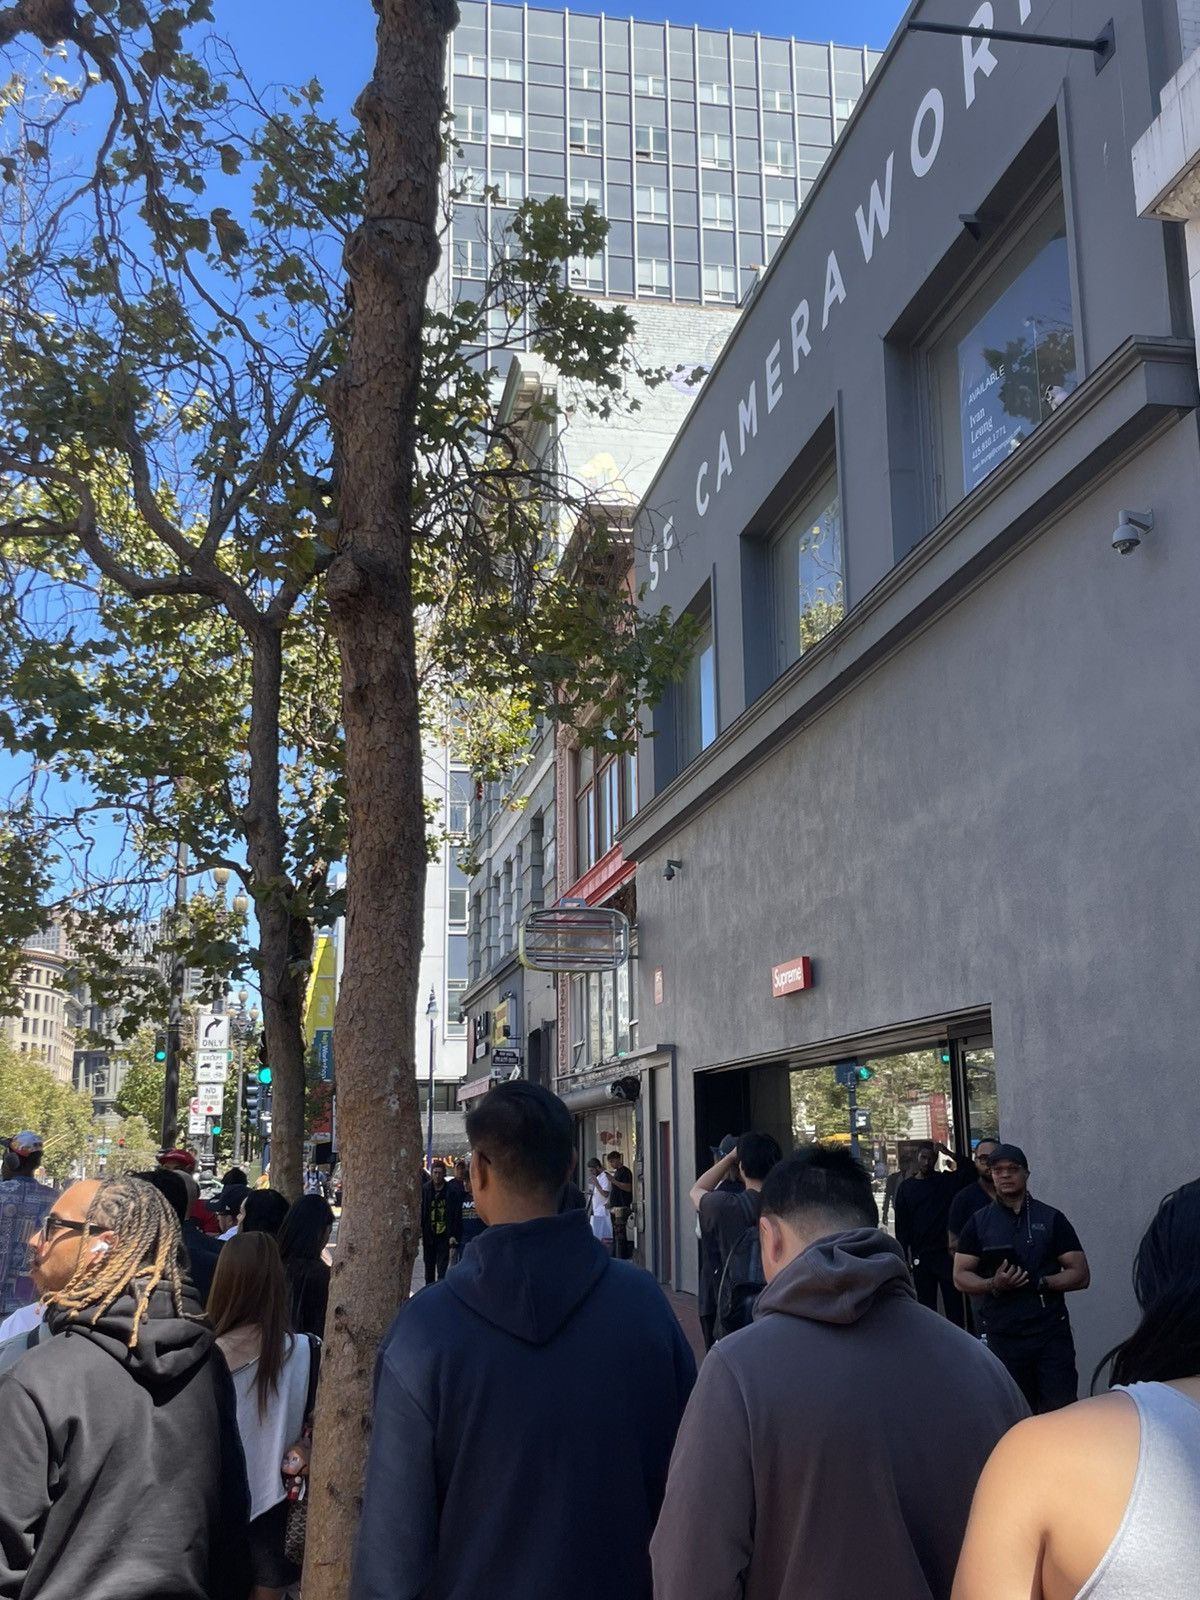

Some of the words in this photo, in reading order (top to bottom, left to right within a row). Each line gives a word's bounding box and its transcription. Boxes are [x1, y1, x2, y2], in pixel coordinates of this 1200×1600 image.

[649, 515, 674, 592] SF
[696, 0, 1031, 516] CAMERAWOR
[968, 364, 1005, 406] AVAILABLE
[969, 407, 985, 428] Ivan
[774, 967, 802, 992] Supreme
